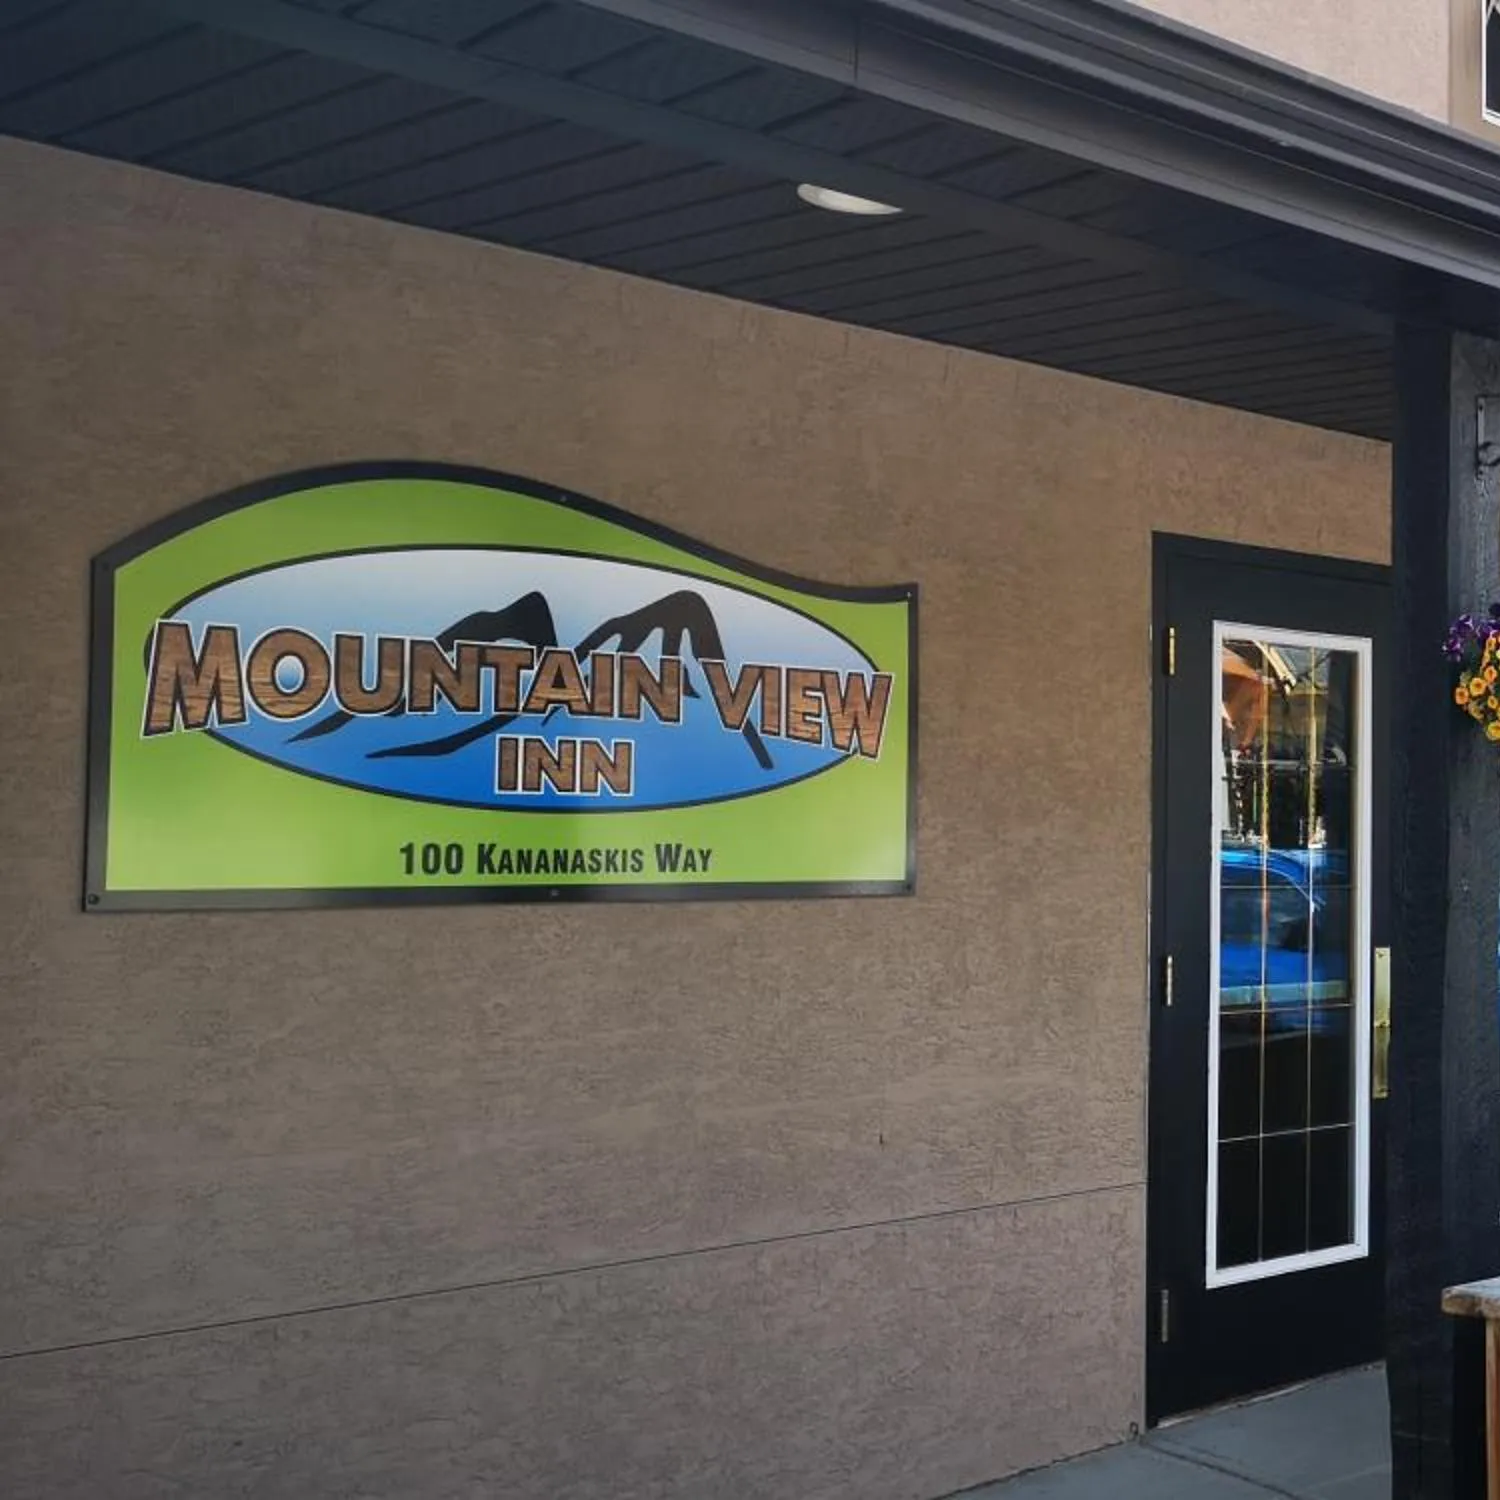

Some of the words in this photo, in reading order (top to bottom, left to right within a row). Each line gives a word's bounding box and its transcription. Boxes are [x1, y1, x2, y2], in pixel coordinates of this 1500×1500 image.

[141, 619, 682, 738] MOUNTAIN
[699, 659, 894, 761] VIEW
[495, 734, 634, 796] INN
[400, 842, 463, 875] 100
